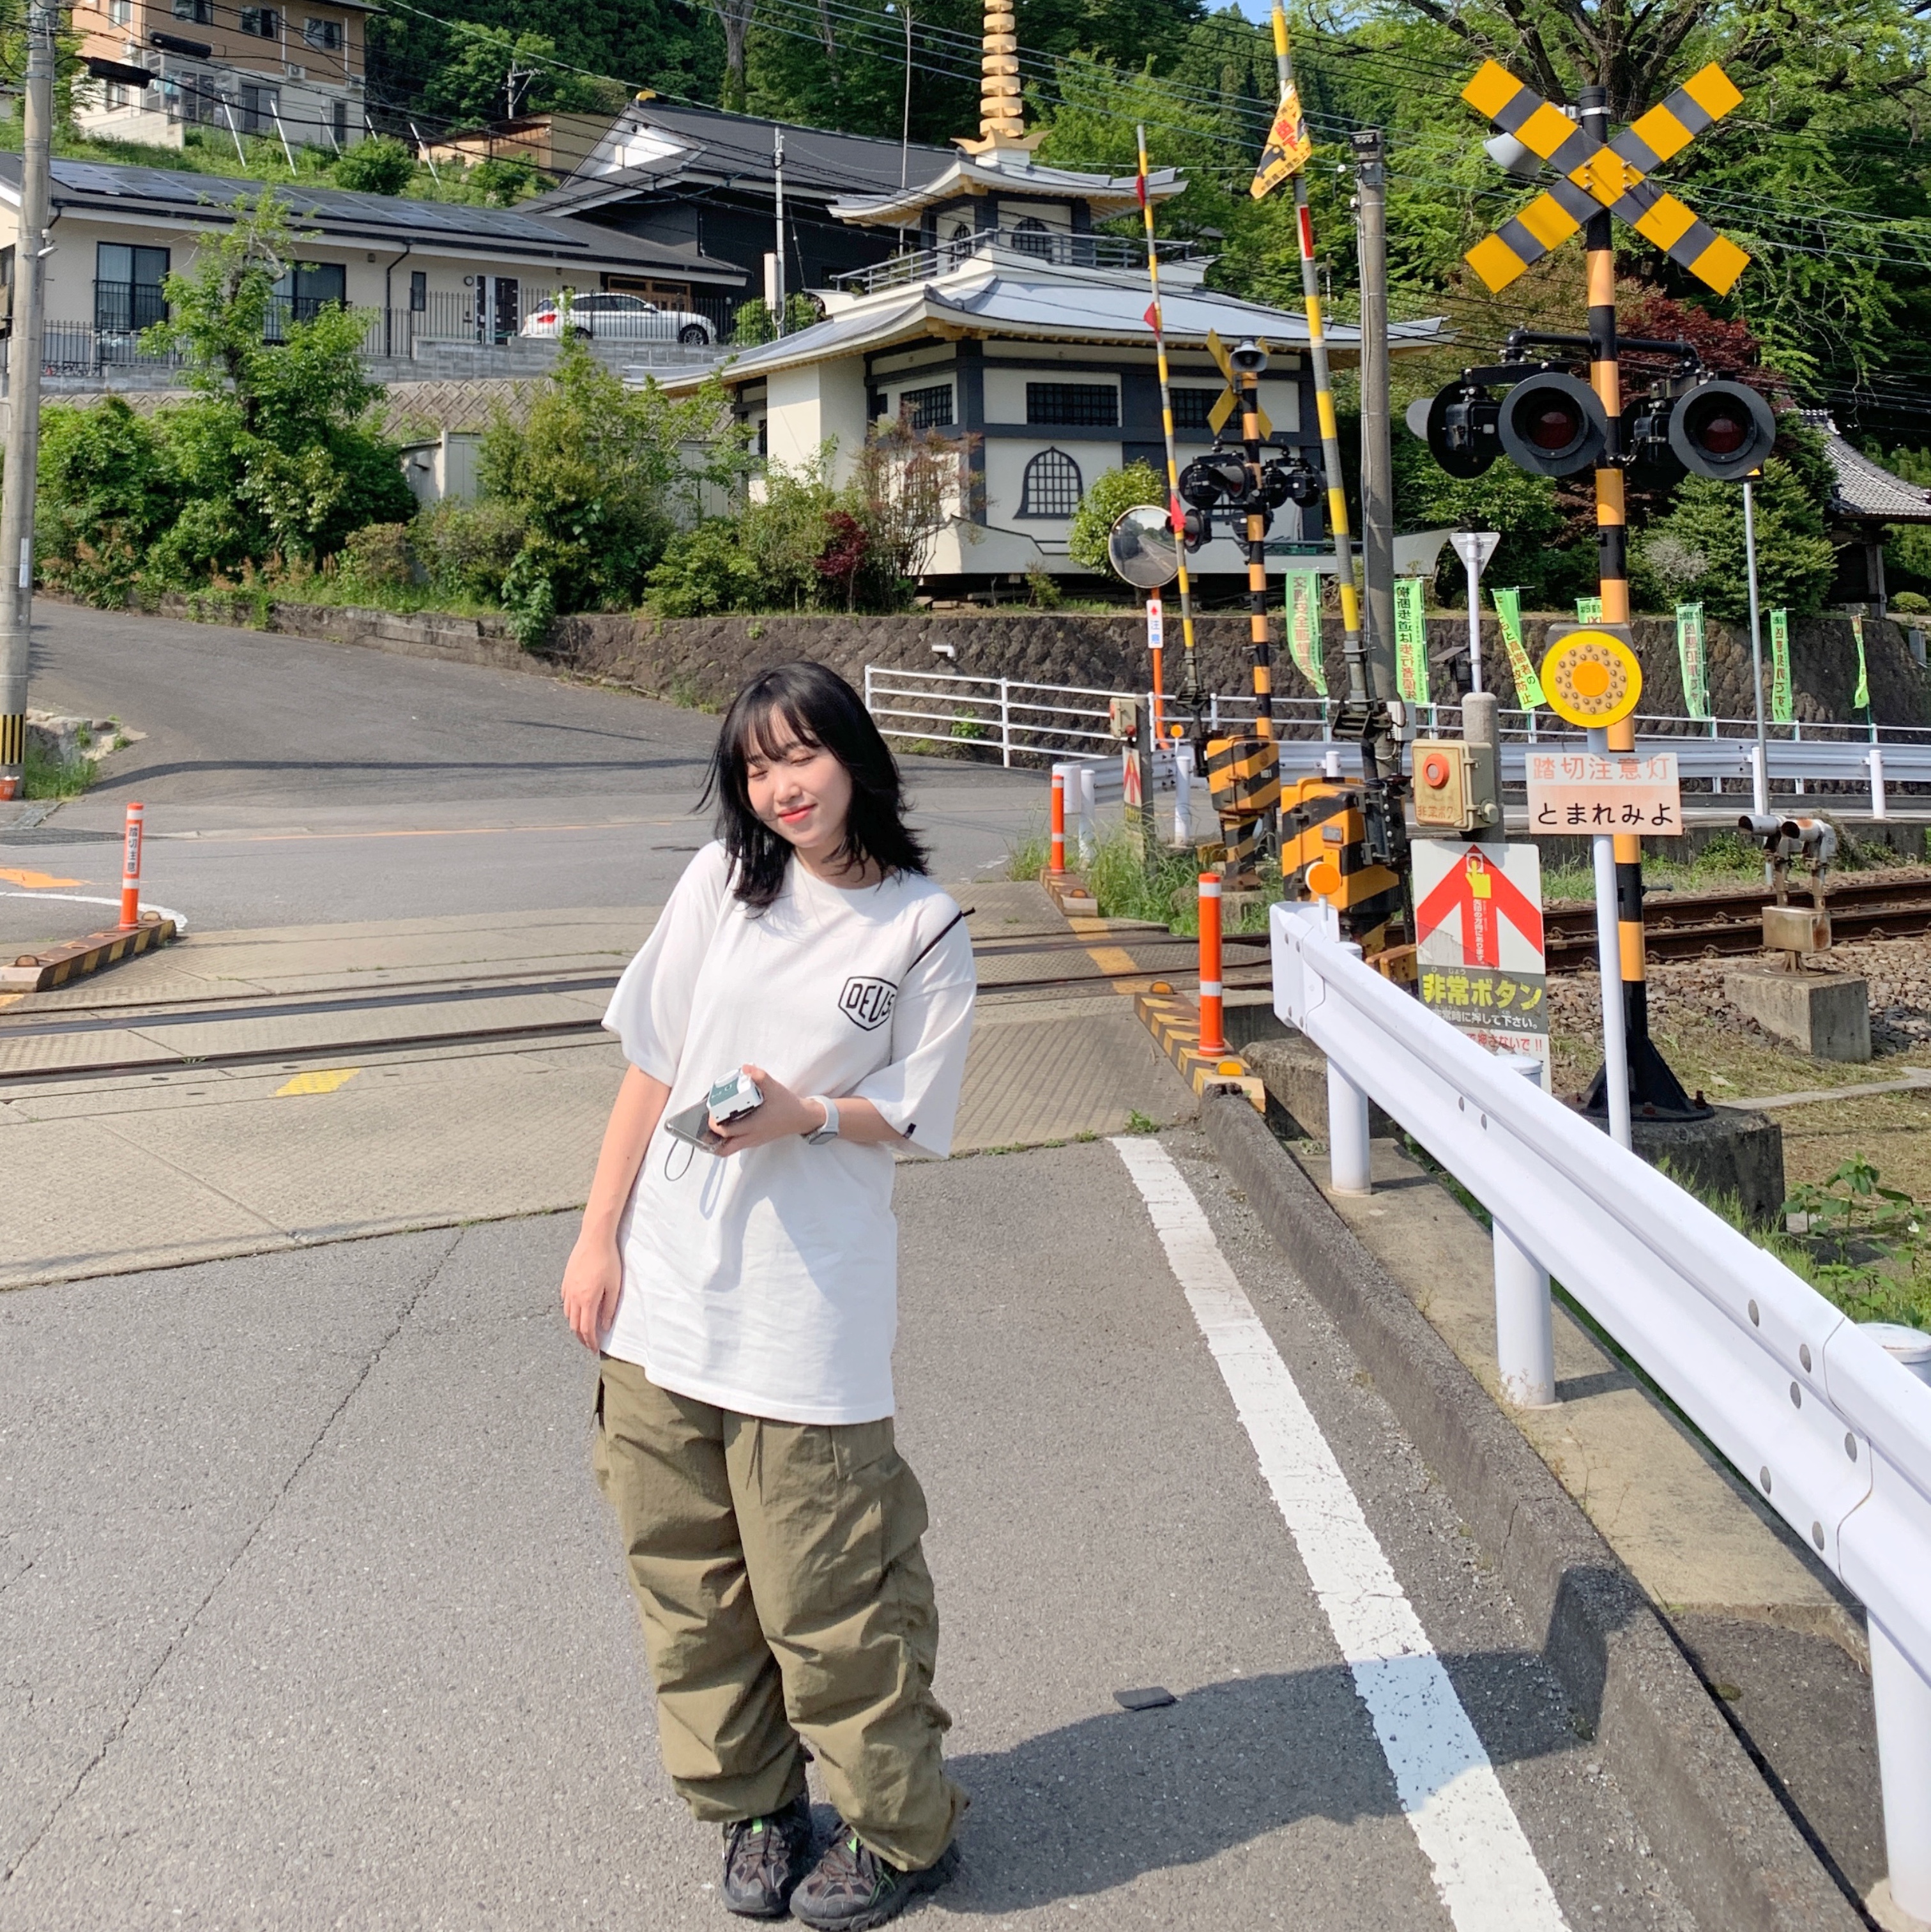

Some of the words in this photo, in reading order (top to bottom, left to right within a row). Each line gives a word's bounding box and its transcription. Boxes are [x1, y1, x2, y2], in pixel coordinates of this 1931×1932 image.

[1534, 756, 1670, 780] 踏切注意灯
[1538, 802, 1673, 825] とまれみよ
[845, 983, 896, 1022] DEUS
[1422, 973, 1543, 1011] 非常ボタン
